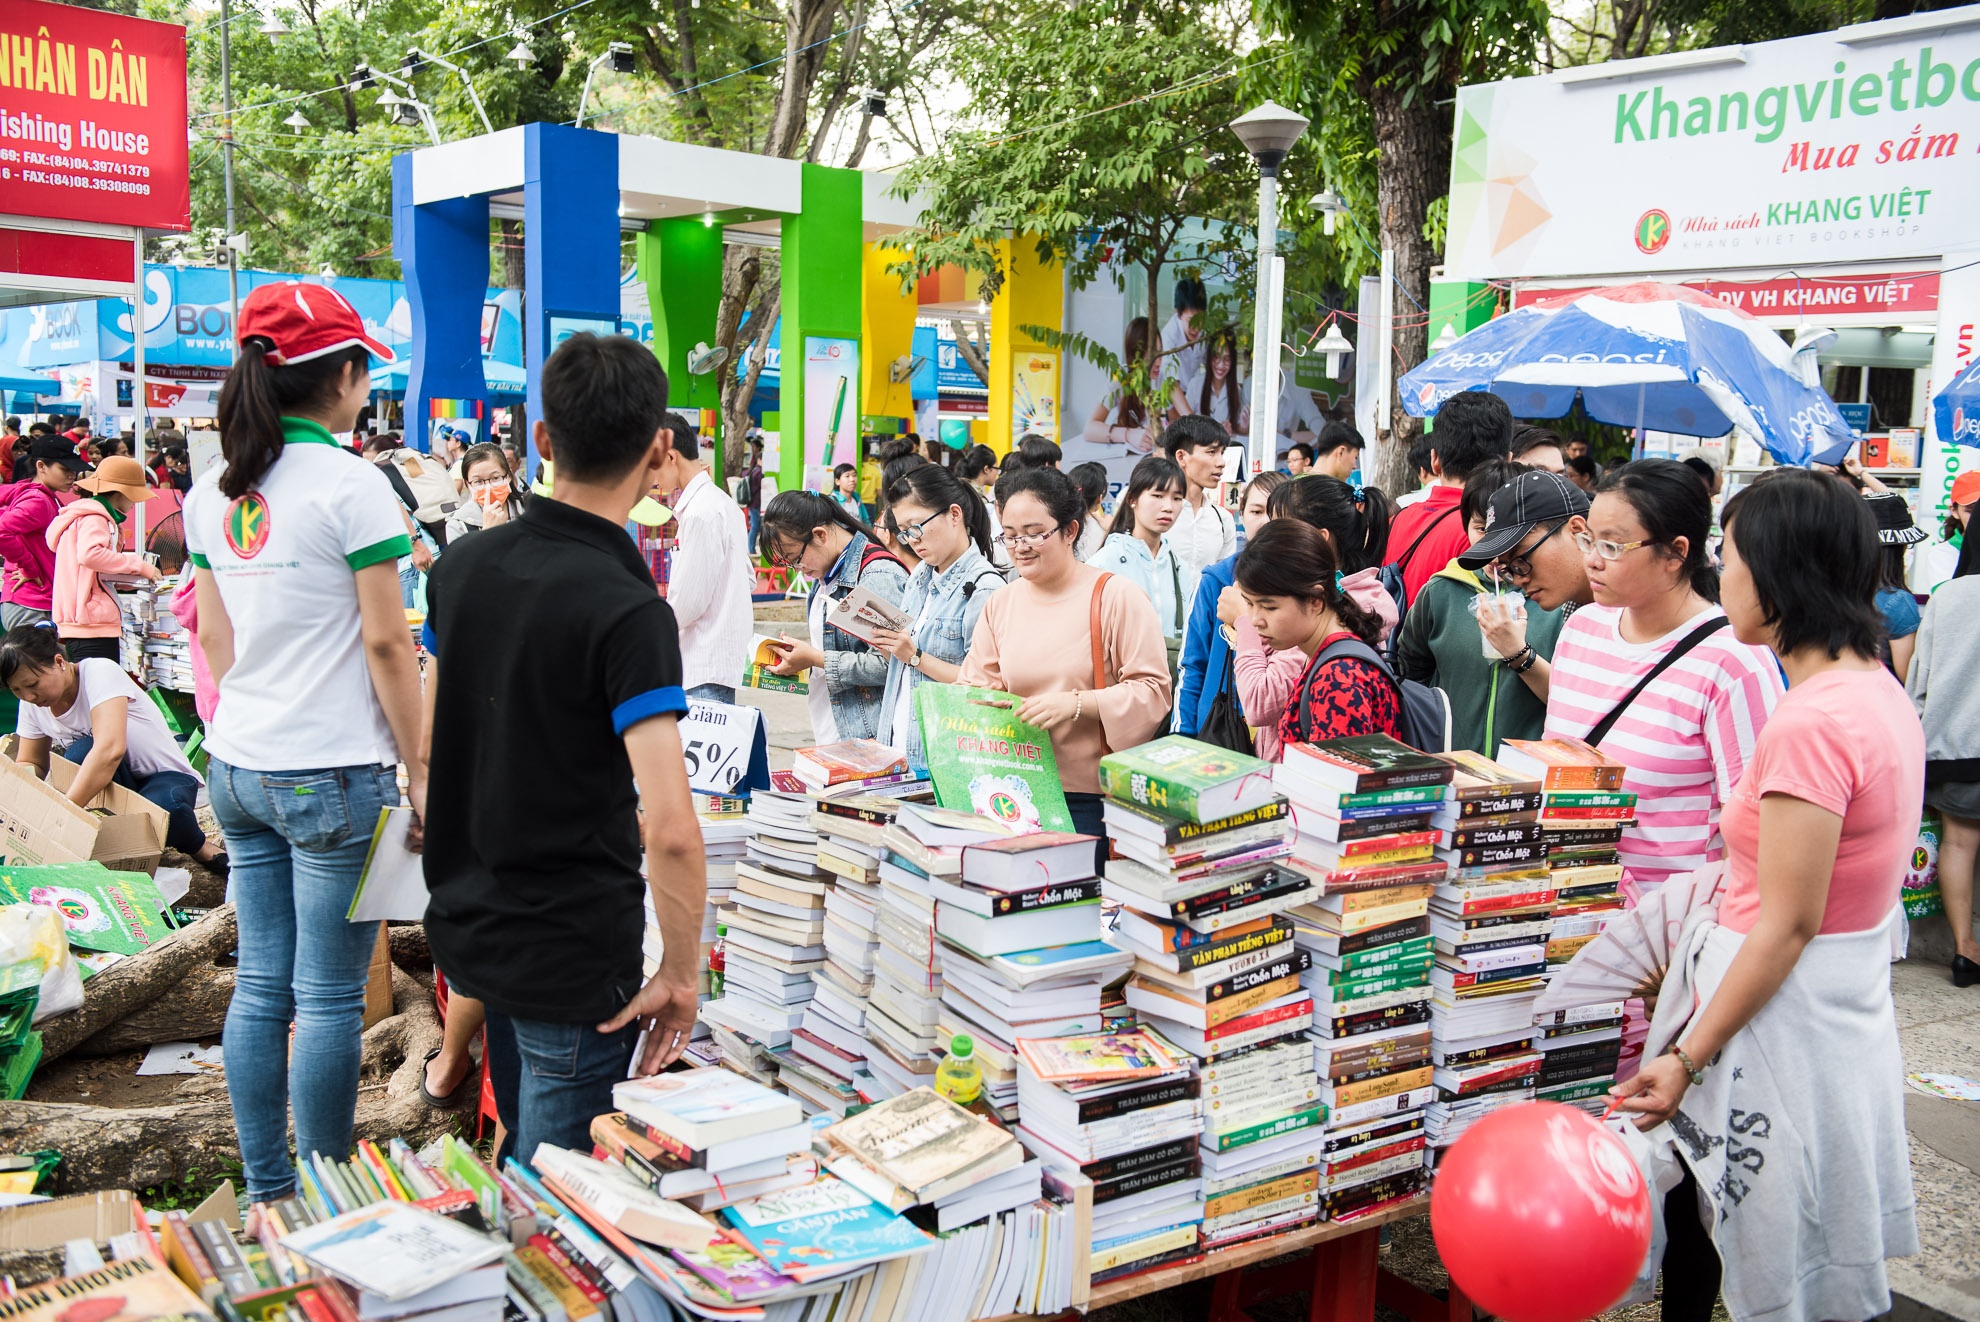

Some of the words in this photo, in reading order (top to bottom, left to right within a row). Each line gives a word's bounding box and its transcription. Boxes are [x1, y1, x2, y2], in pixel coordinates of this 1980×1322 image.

[88, 39, 148, 107] DÂN
[0, 109, 72, 151] ishing
[80, 120, 149, 155] House
[1782, 141, 1860, 174] Mua
[1875, 124, 1959, 165] sắm
[1680, 215, 1718, 233] Nhà
[1722, 212, 1760, 230] sách
[1767, 195, 1861, 227] KHANG
[1870, 187, 1931, 223] VIỆT
[1682, 237, 1740, 249] KHANG
[1755, 234, 1796, 246] VIET
[1810, 226, 1921, 242] BOOKSHOP
[1751, 290, 1779, 307] VH
[1783, 286, 1857, 306] KHANG
[1864, 280, 1913, 305] VIỆT
[177, 305, 231, 337] BO
[1425, 346, 1514, 372] pepsi
[169, 369, 190, 377] TNHH
[687, 704, 727, 726] Giảm
[957, 736, 1009, 755] KHANG
[1012, 741, 1042, 762] VIỆT
[684, 740, 740, 786] 5%
[1257, 804, 1278, 819] VIỆT
[1212, 944, 1237, 962] PHẠM
[1238, 932, 1263, 954] TIẾNG
[1264, 927, 1285, 947] VIỆT
[1141, 1094, 1158, 1104] NĂM
[1159, 1091, 1169, 1100] CÔ
[1156, 1150, 1166, 1159] CÔ
[1142, 1175, 1159, 1185] NĂM
[1159, 1170, 1169, 1180] CÔ
